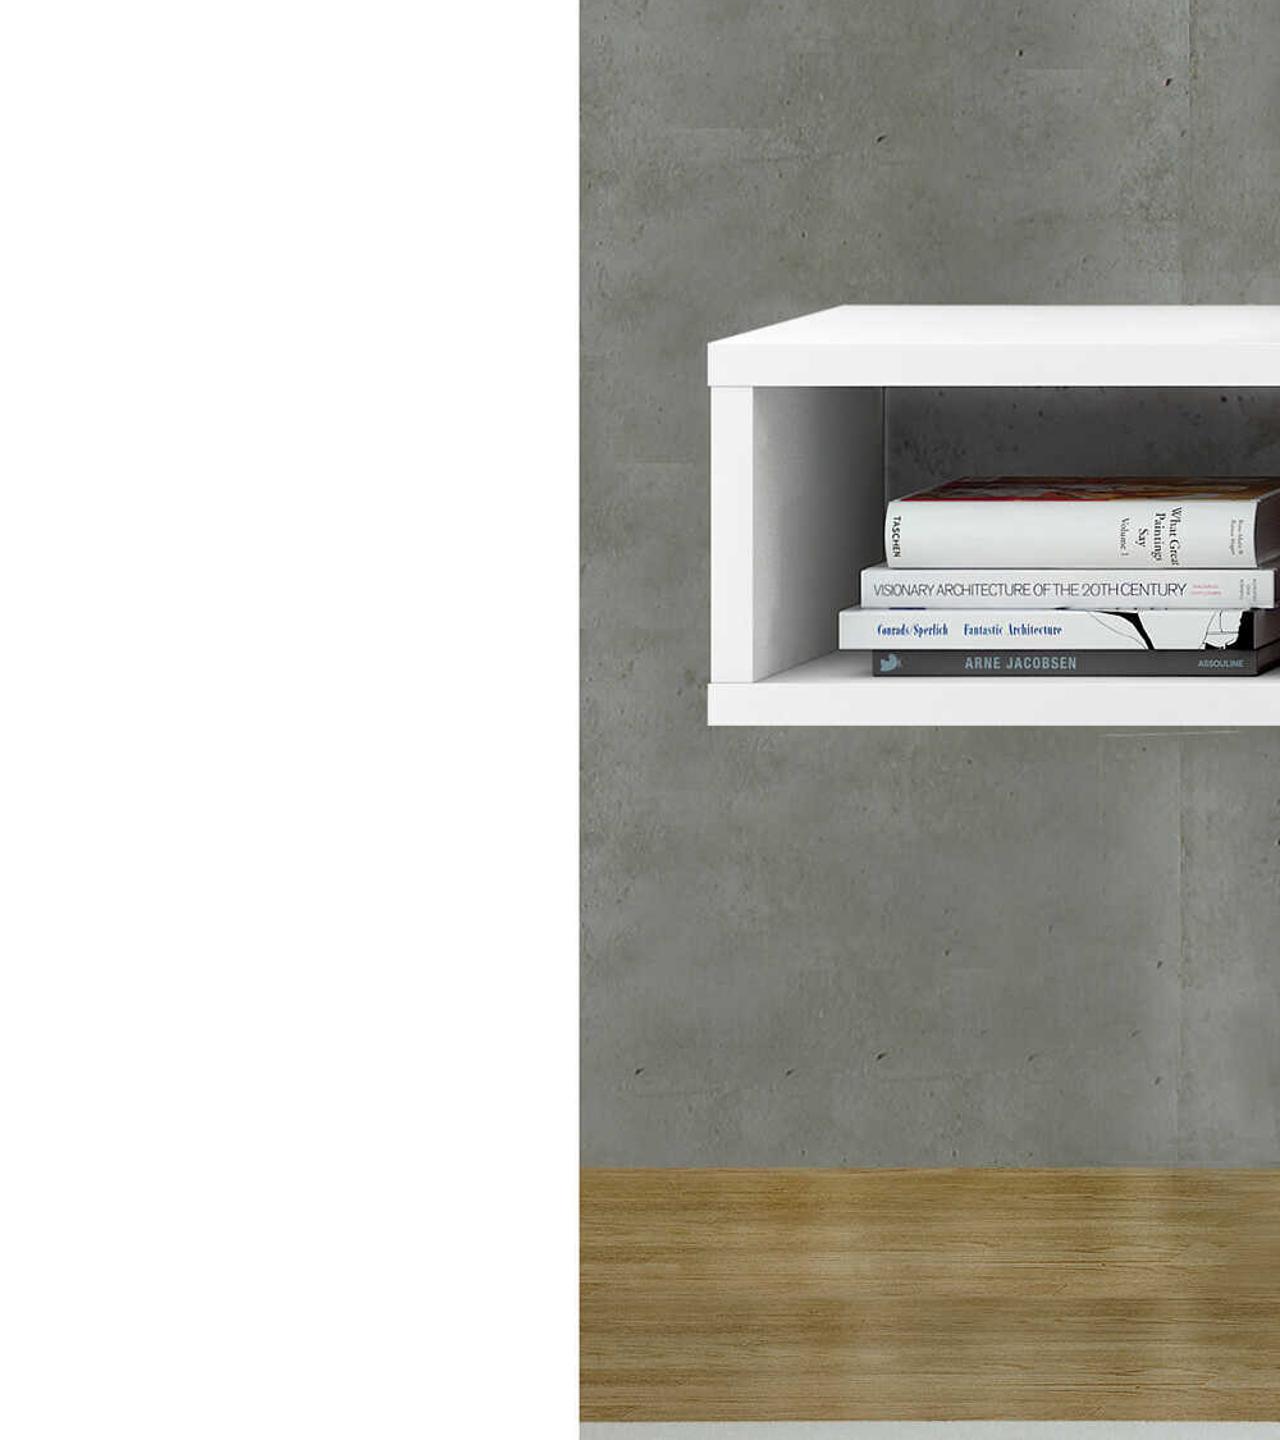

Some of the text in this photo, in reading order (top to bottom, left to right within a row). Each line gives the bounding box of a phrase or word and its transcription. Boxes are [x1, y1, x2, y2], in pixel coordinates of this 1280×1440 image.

[1169, 507, 1182, 537] What
[892, 516, 901, 558] TASCHEN
[1135, 528, 1149, 547] Say
[873, 583, 935, 596] VISIONARY
[936, 583, 1031, 596] ARCHITECTURE
[1033, 583, 1051, 596] OF
[1051, 583, 1079, 596] THE
[1083, 583, 1119, 596] 20TH
[1120, 583, 1187, 597] CENTURY
[963, 623, 1062, 636] Fantastic Architecture
[965, 656, 1076, 669] ARNE JACOBSEN
